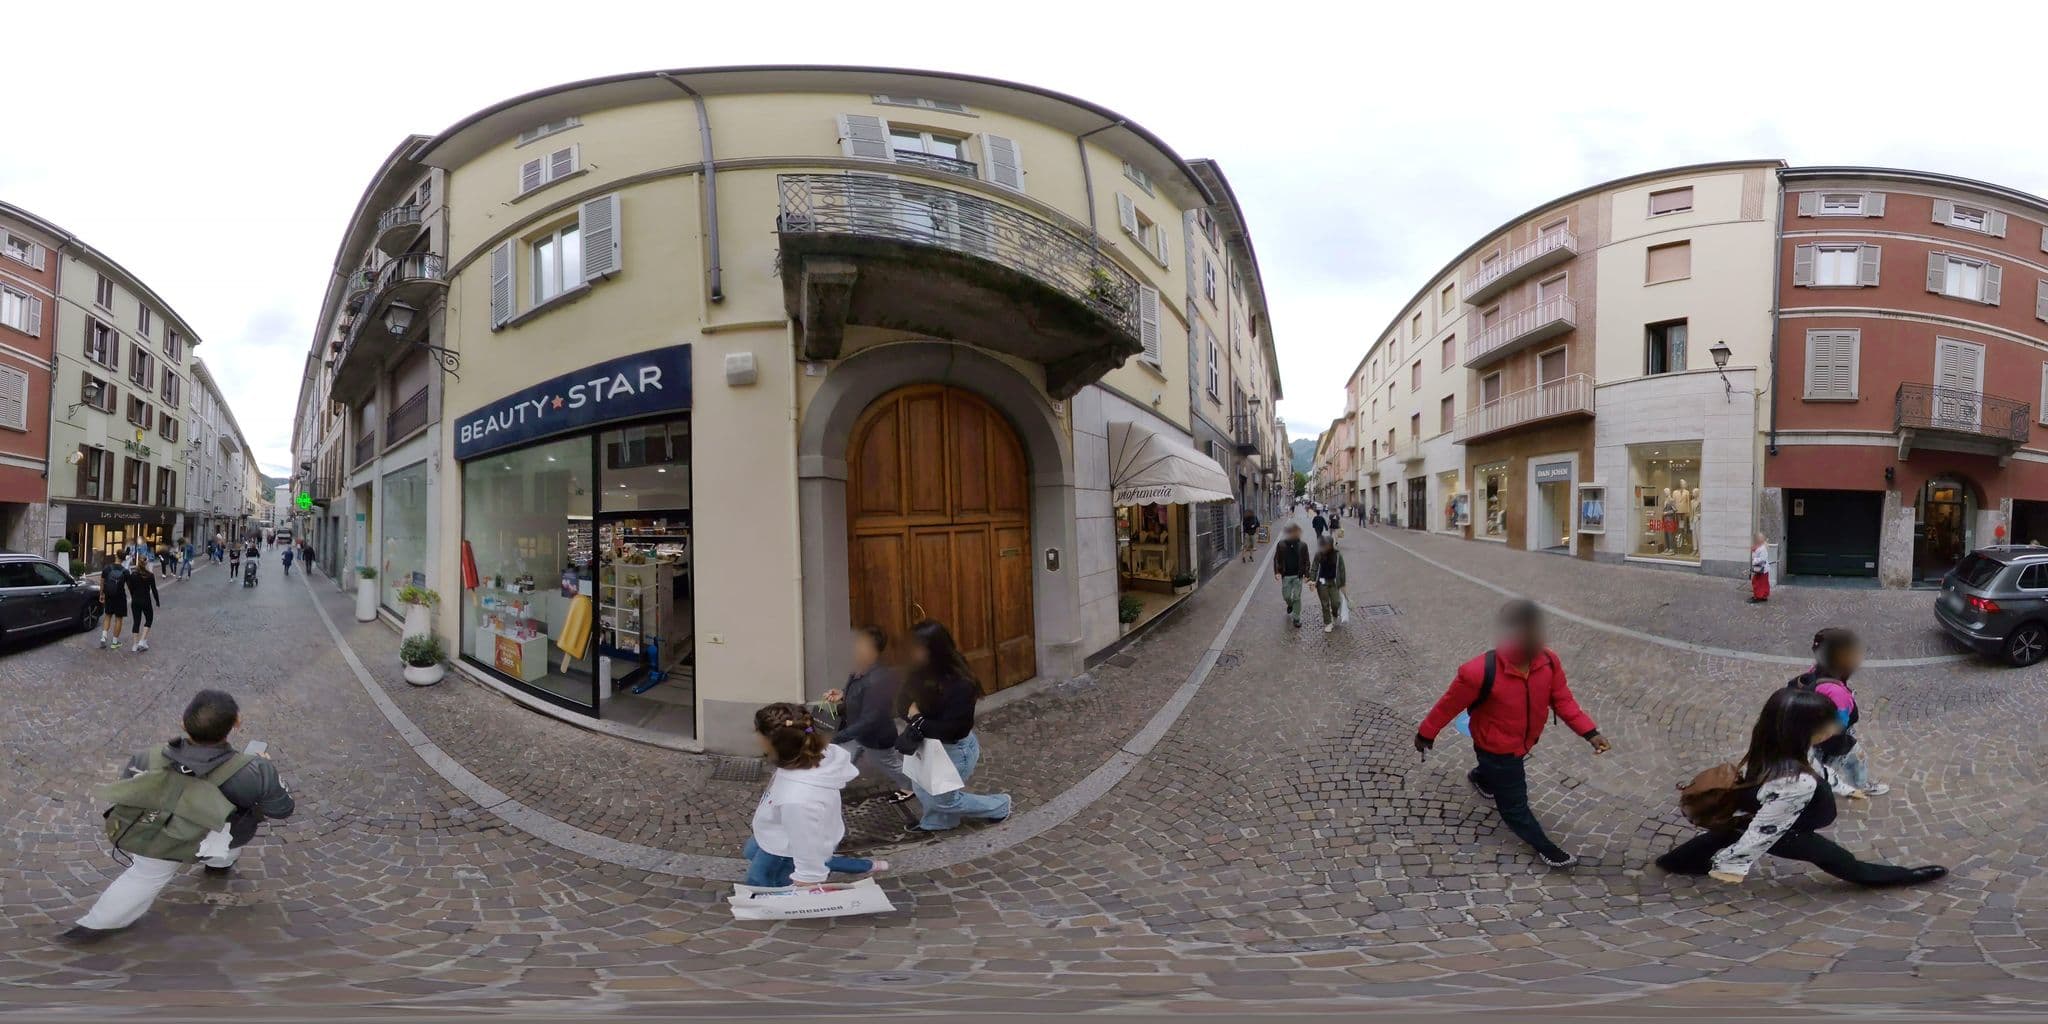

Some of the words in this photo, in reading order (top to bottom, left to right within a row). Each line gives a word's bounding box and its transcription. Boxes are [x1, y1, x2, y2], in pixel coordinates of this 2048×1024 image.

[461, 395, 549, 444] BEAUTY
[568, 366, 663, 409] STAR
[1537, 470, 1550, 478] DAN
[1550, 467, 1568, 478] JOHN
[1115, 485, 1172, 503] profumeria
